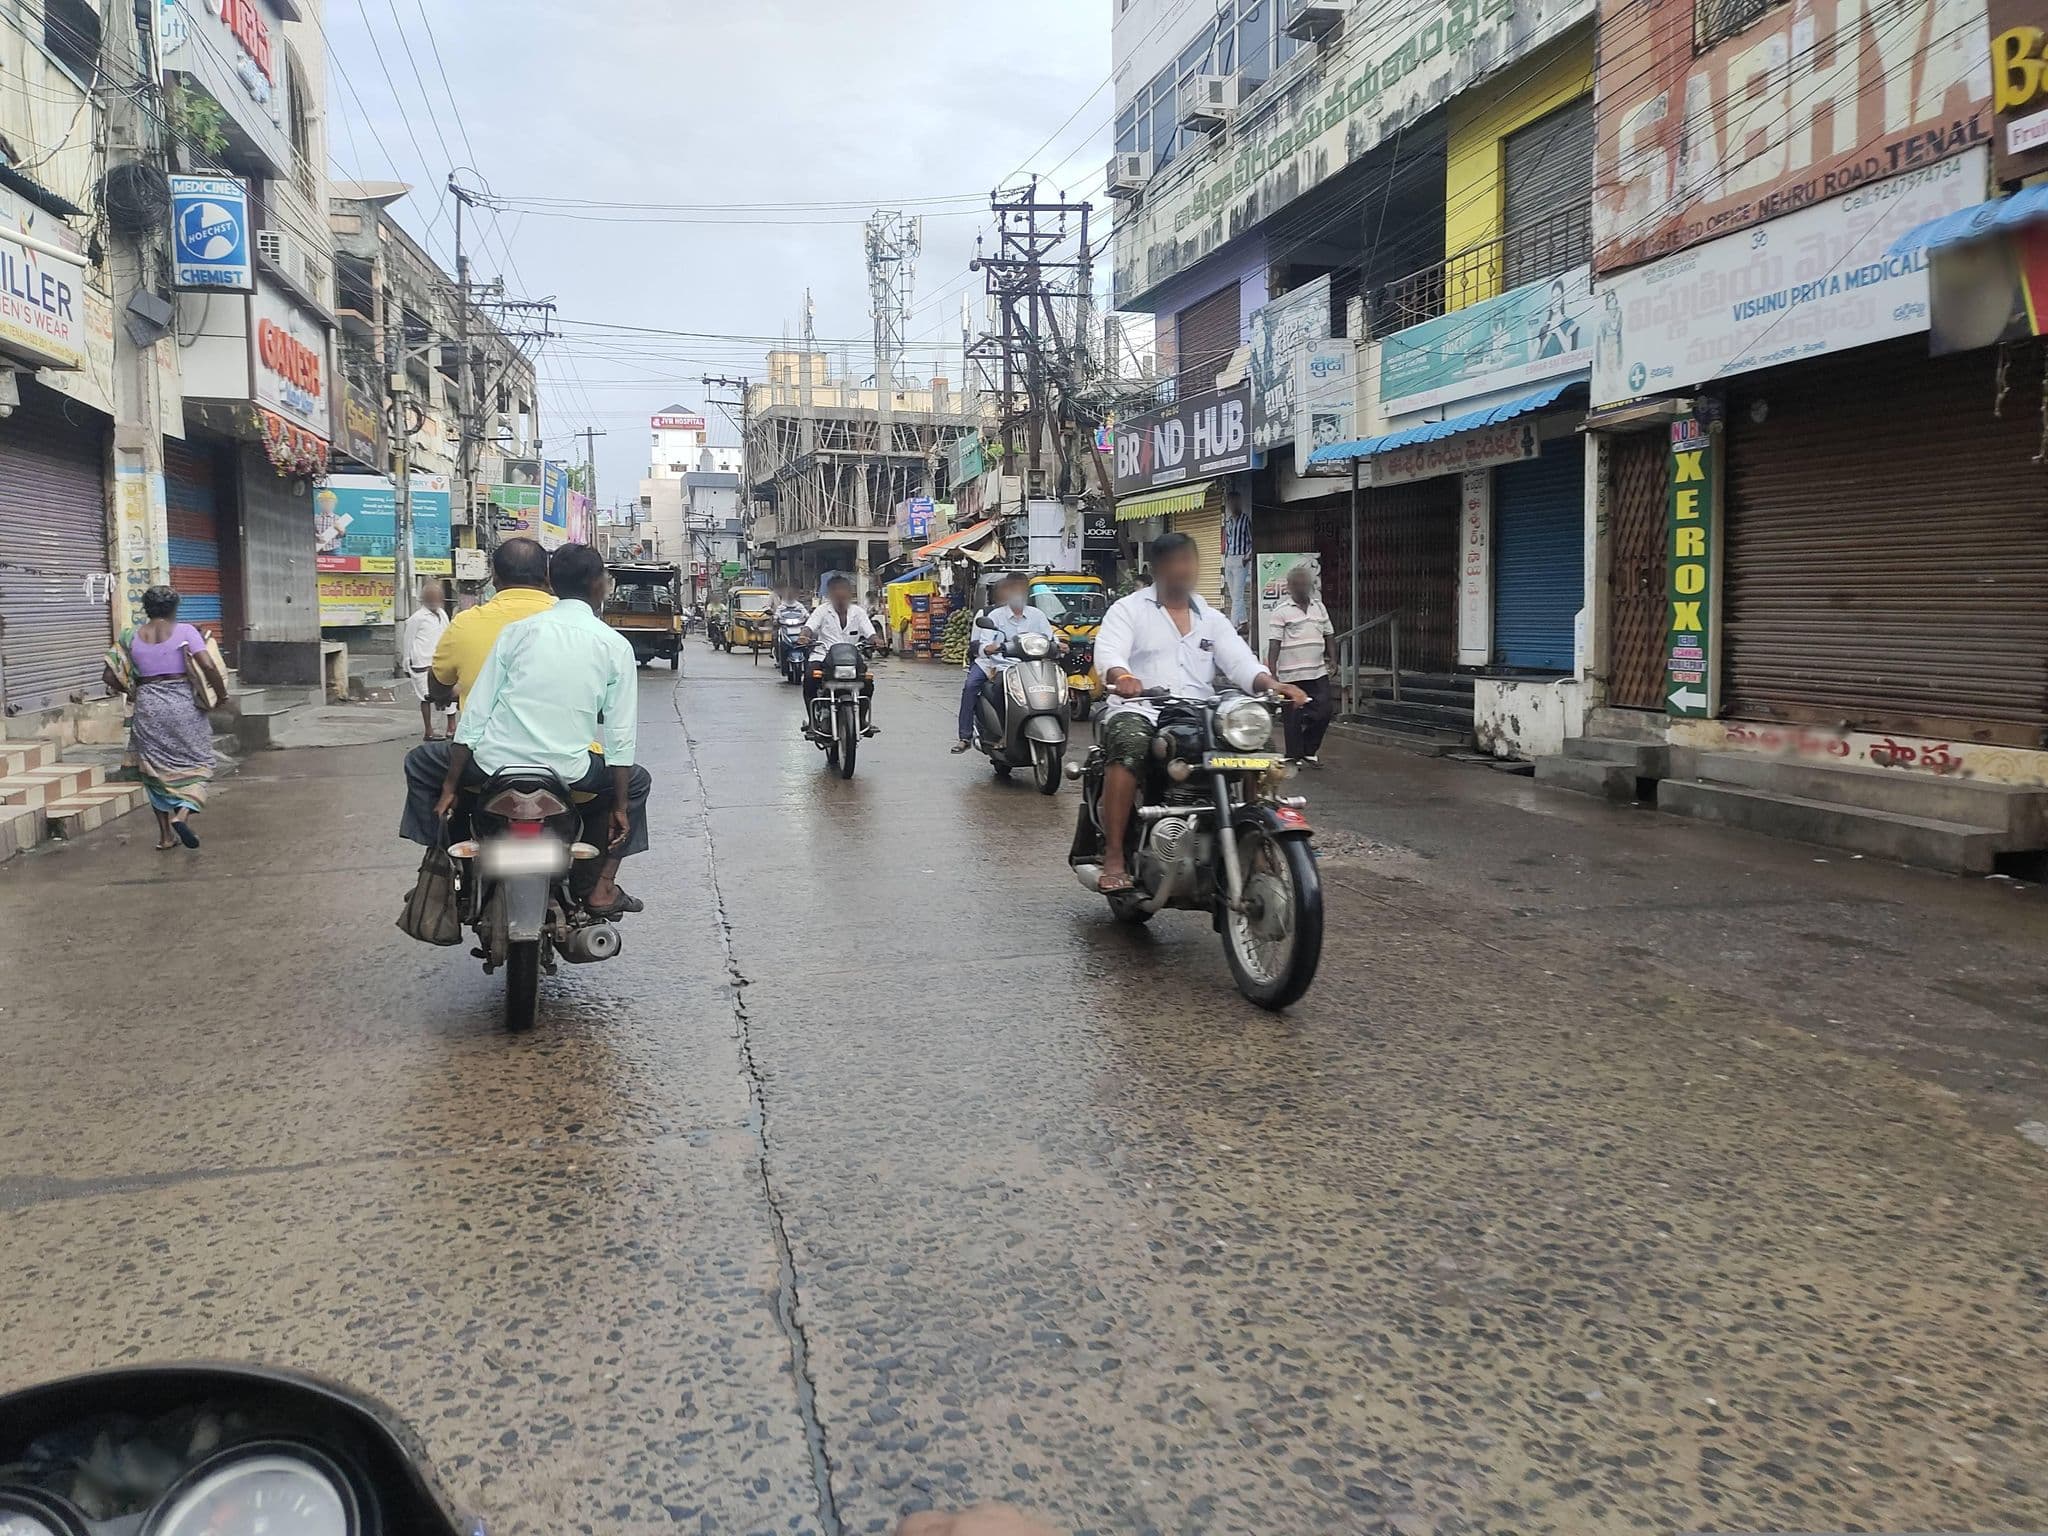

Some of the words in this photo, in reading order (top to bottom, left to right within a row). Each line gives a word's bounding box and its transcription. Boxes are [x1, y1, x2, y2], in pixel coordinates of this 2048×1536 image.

[1990, 26, 2048, 115] B
[174, 180, 242, 198] MEDICINES
[1759, 180, 1817, 218] NEHRU
[188, 222, 233, 244] HOECHST
[181, 269, 244, 284] CHEMIST
[1732, 289, 1788, 322] VISHNU
[1791, 275, 1841, 306] PRIYA
[33, 308, 69, 342] WEAR
[258, 317, 321, 397] GANESH
[675, 417, 704, 426] HOSPITAL
[1193, 399, 1245, 460] HUB
[1084, 528, 1118, 536] JOCKEY
[1672, 450, 1706, 632] XEROX
